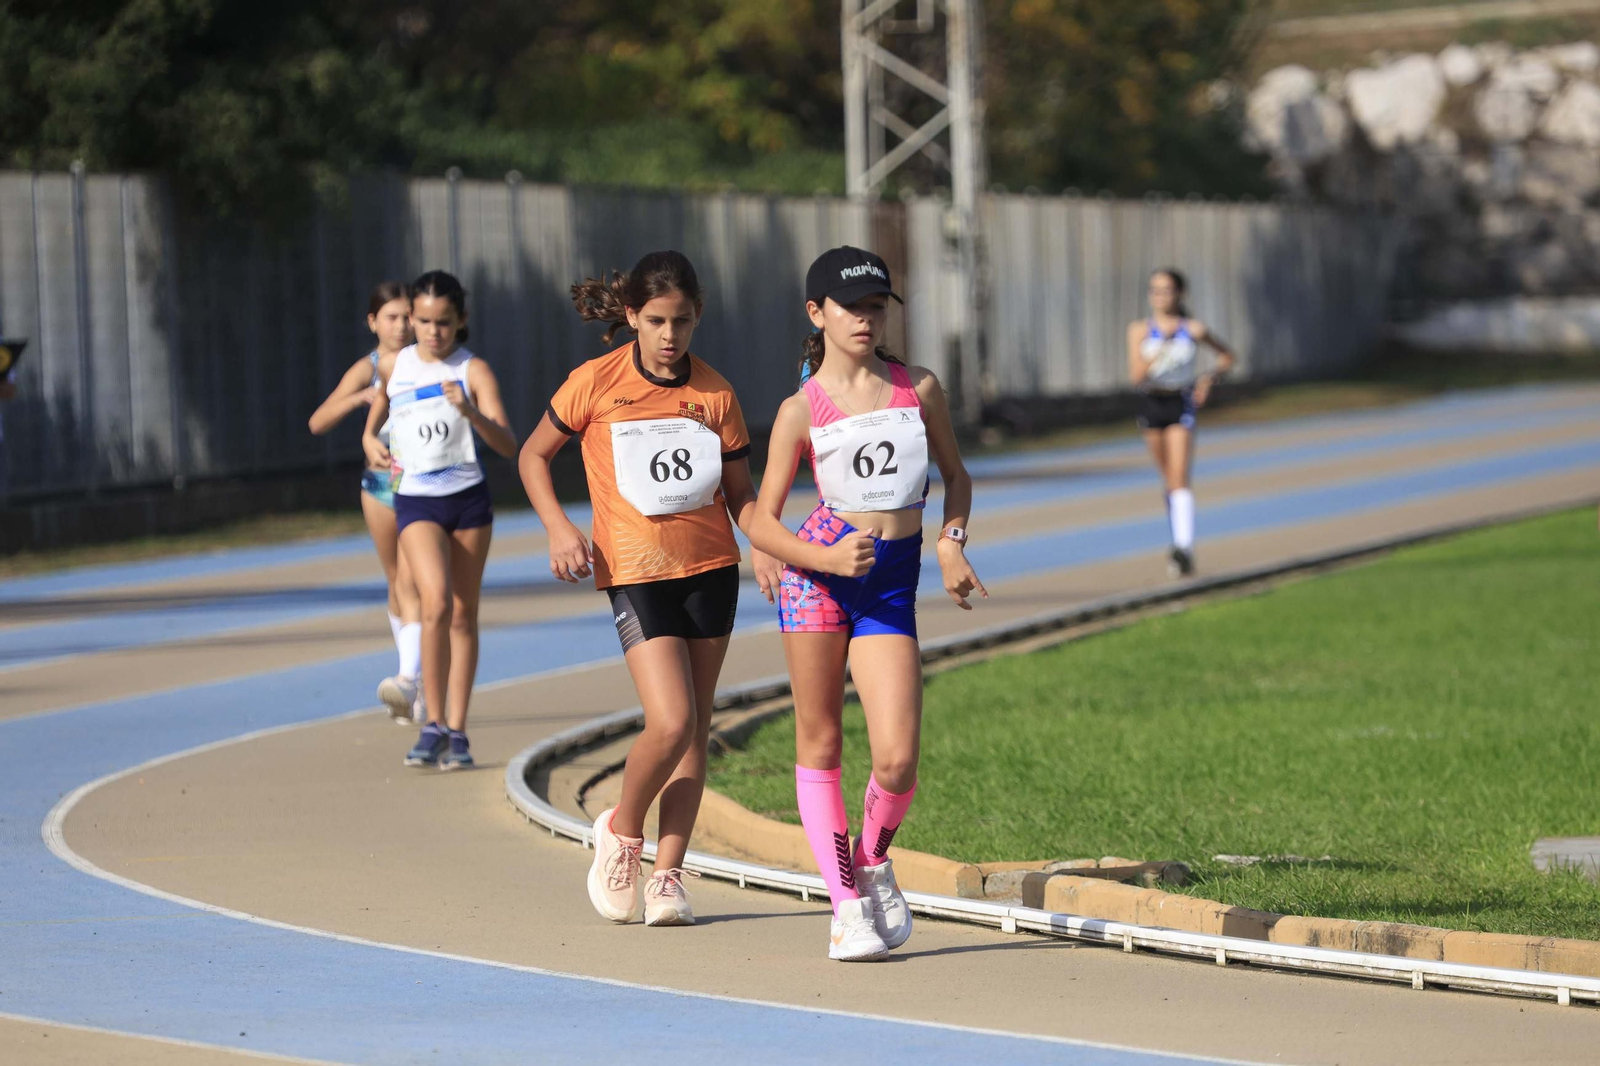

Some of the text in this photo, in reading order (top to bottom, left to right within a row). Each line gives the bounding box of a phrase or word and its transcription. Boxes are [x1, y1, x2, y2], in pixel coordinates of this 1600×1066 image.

[840, 261, 886, 280] marina
[418, 420, 449, 447] 99
[649, 448, 693, 483] 68
[853, 440, 898, 479] 62
[663, 494, 688, 503] docunova
[868, 489, 895, 500] docunova
